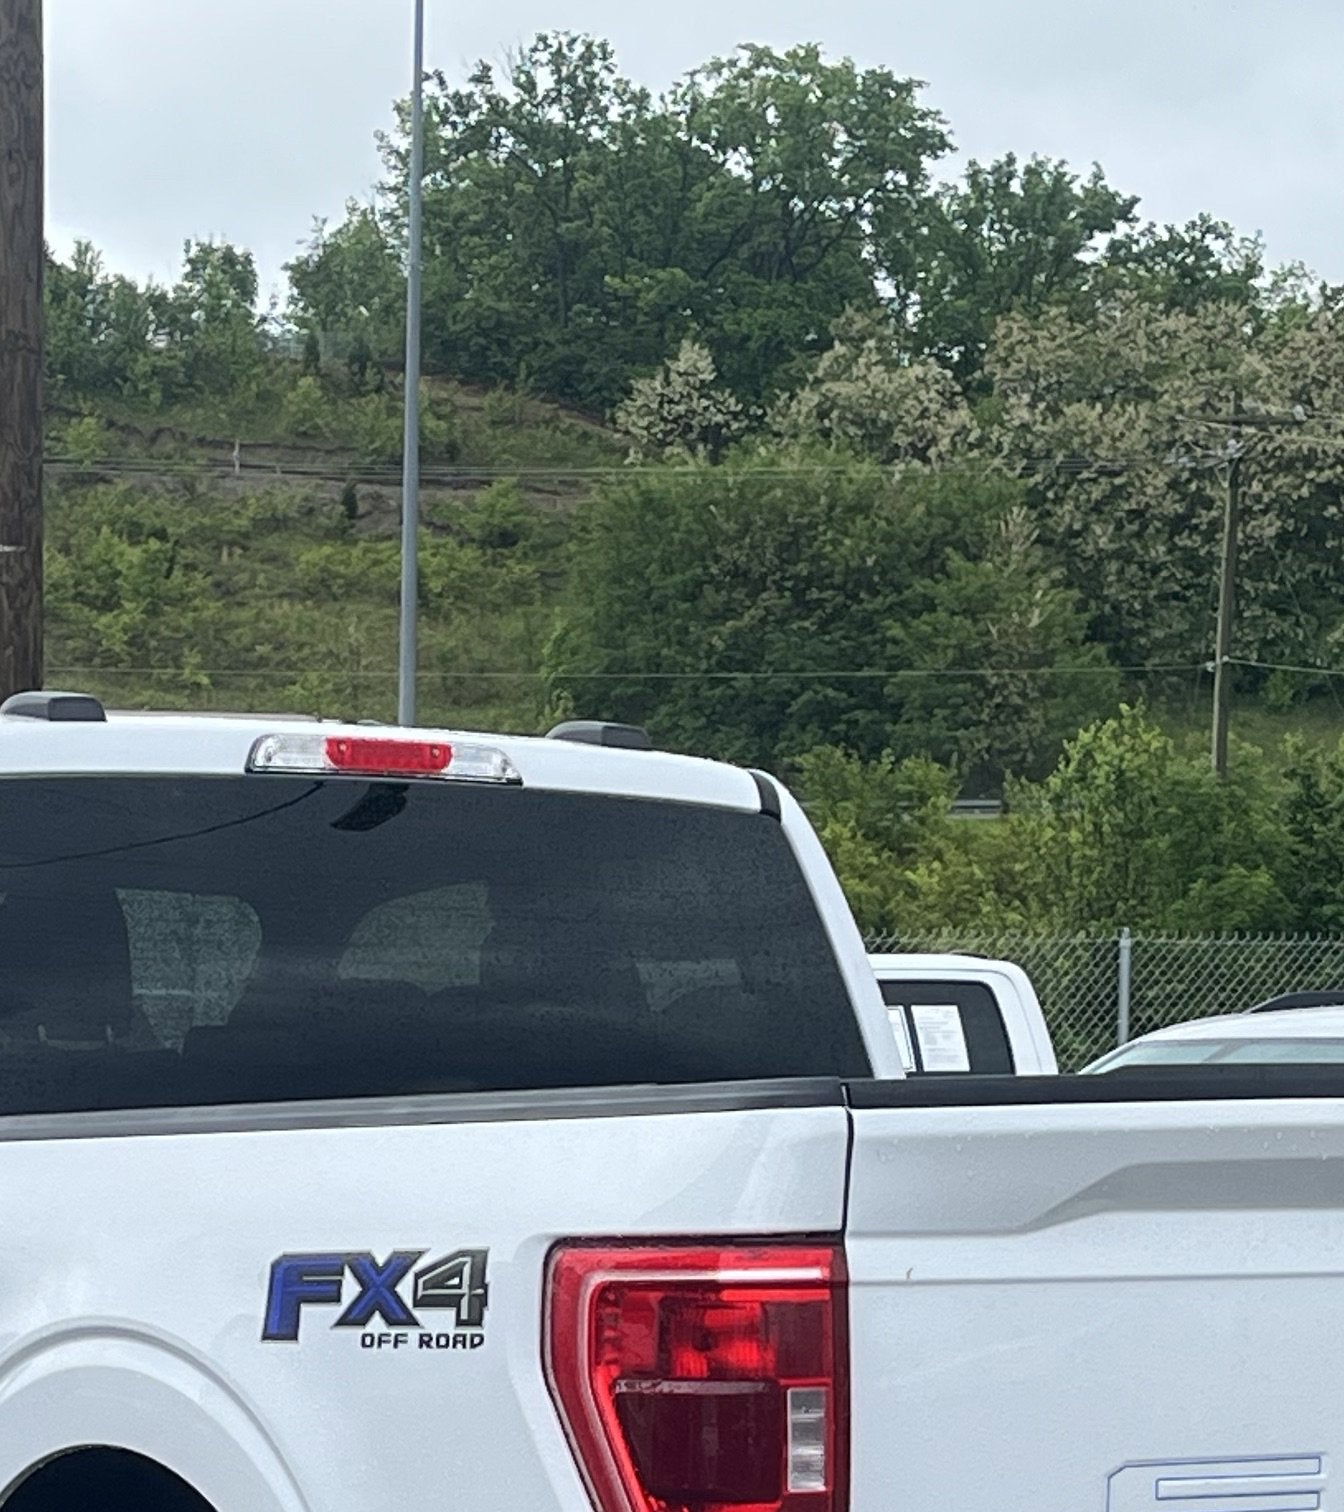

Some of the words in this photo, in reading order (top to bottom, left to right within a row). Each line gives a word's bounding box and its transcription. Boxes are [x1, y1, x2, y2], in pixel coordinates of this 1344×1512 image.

[261, 1247, 490, 1342] FX4
[360, 1333, 409, 1349] OFF
[418, 1333, 485, 1349] ROAD
